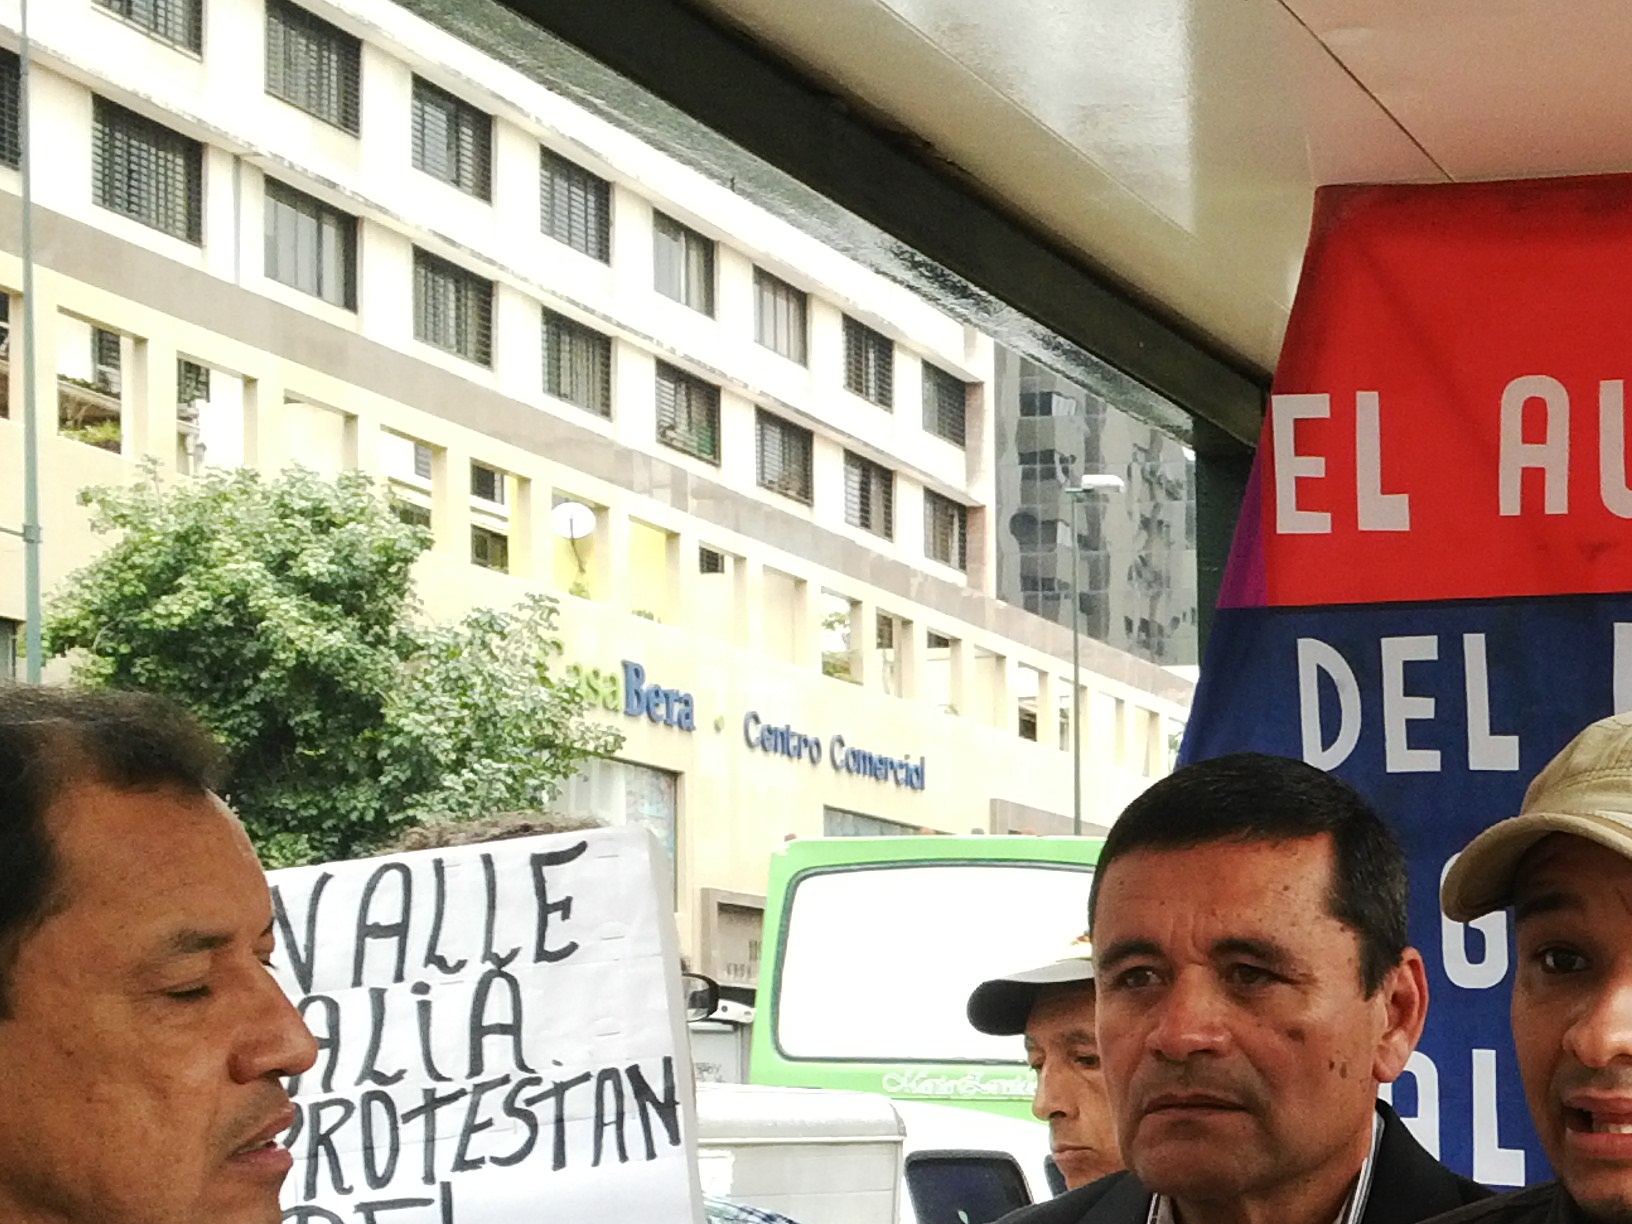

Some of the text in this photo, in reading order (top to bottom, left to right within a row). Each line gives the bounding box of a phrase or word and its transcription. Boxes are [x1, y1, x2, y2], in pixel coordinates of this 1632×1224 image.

[1272, 391, 1410, 534] EL
[744, 711, 925, 790] Centro Comercial
[1297, 632, 1519, 773] DEL
[1377, 1050, 1525, 1186] AL
